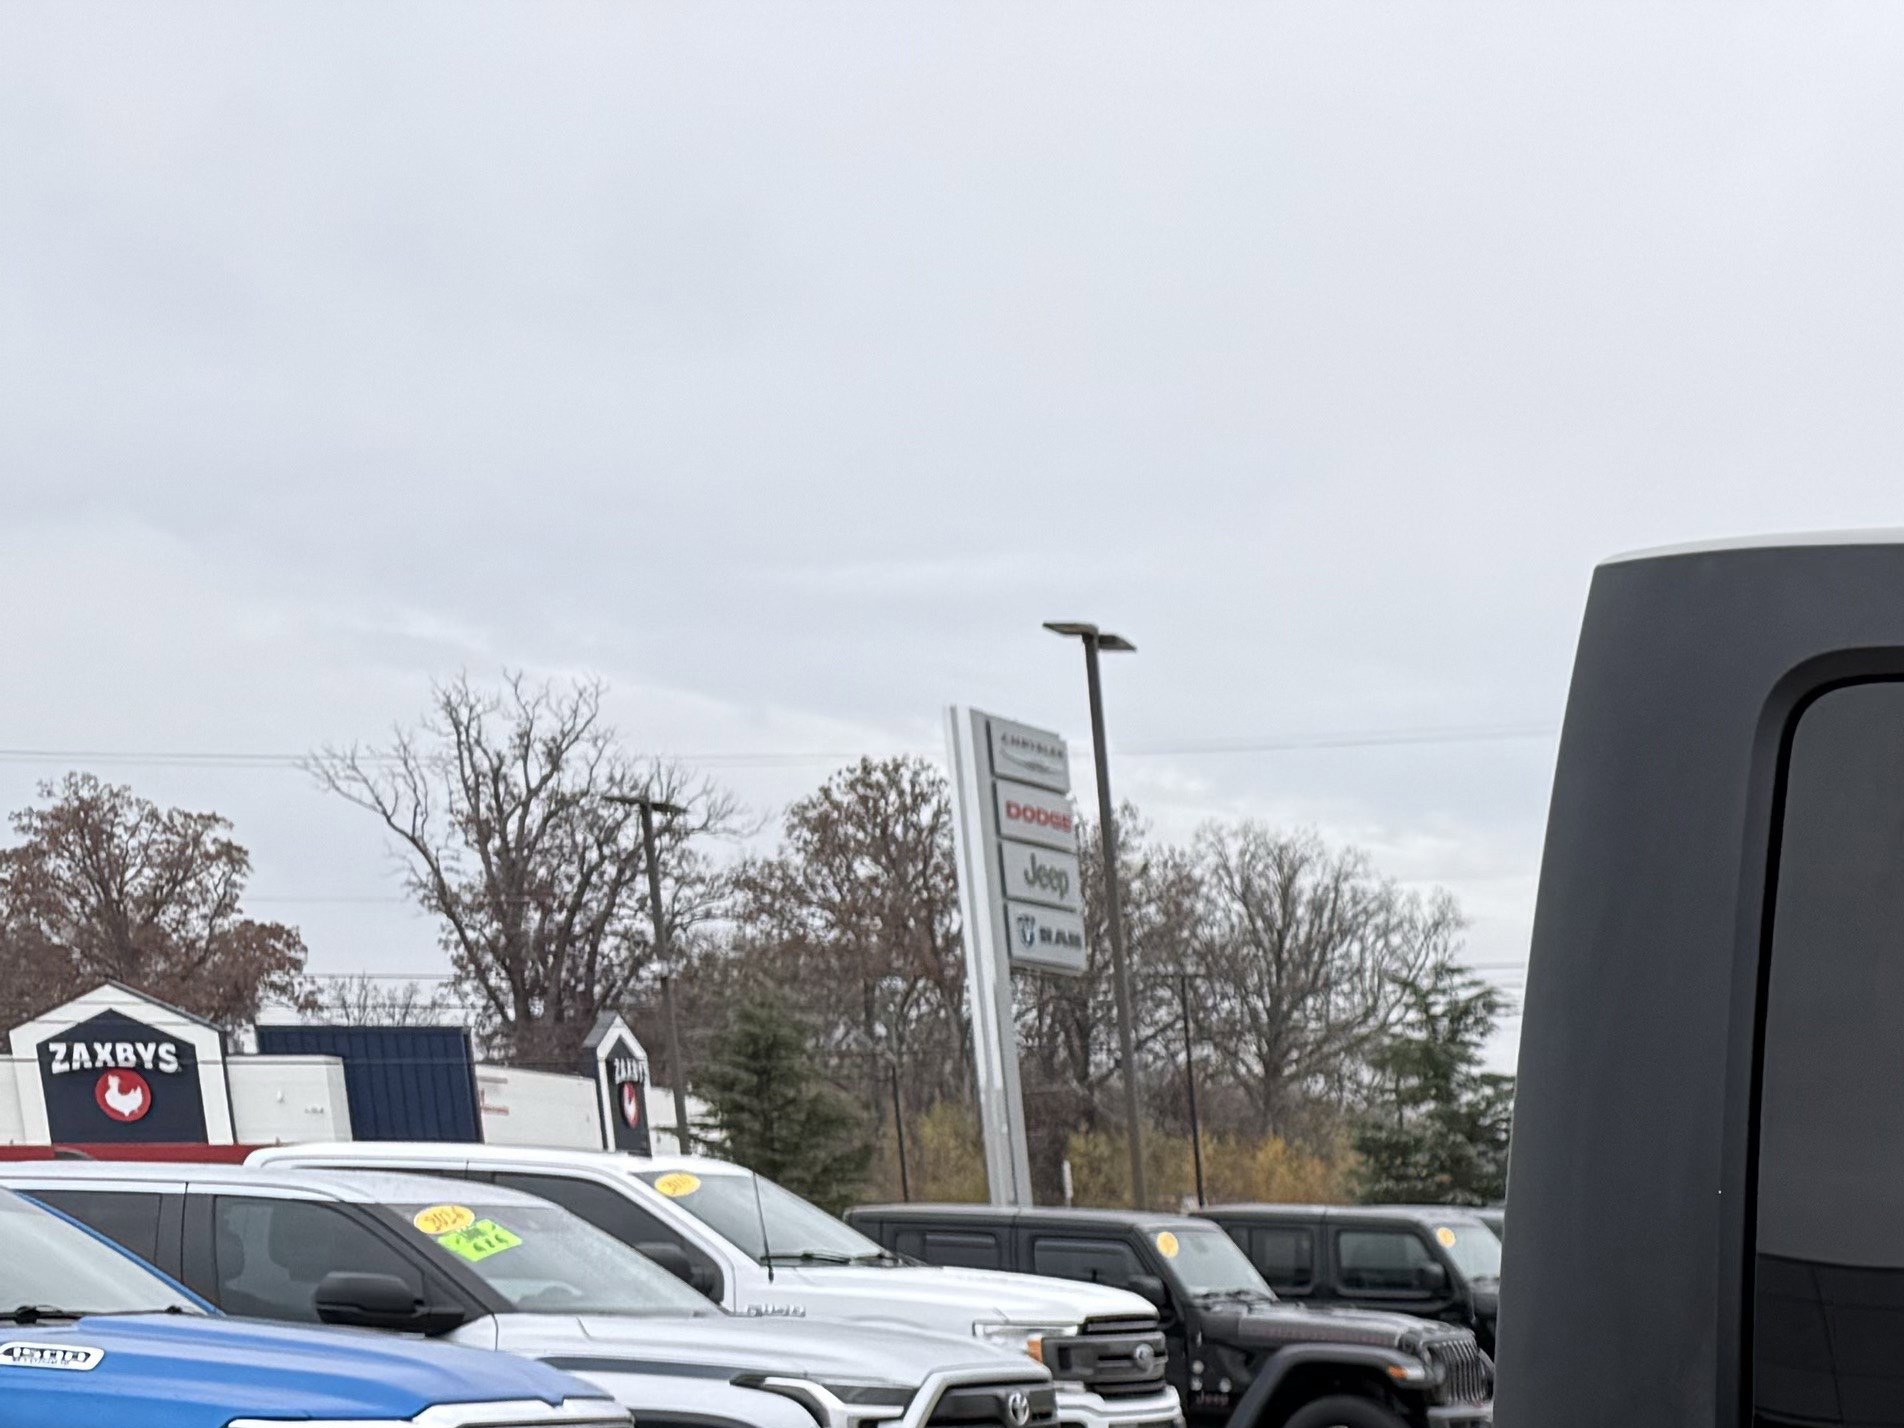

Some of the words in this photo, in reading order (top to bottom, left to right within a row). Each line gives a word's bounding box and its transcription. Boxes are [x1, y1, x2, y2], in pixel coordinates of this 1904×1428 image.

[1006, 800, 1073, 833] DODGE
[1023, 852, 1070, 899] Jeep
[49, 1042, 179, 1075] ZAXBYS
